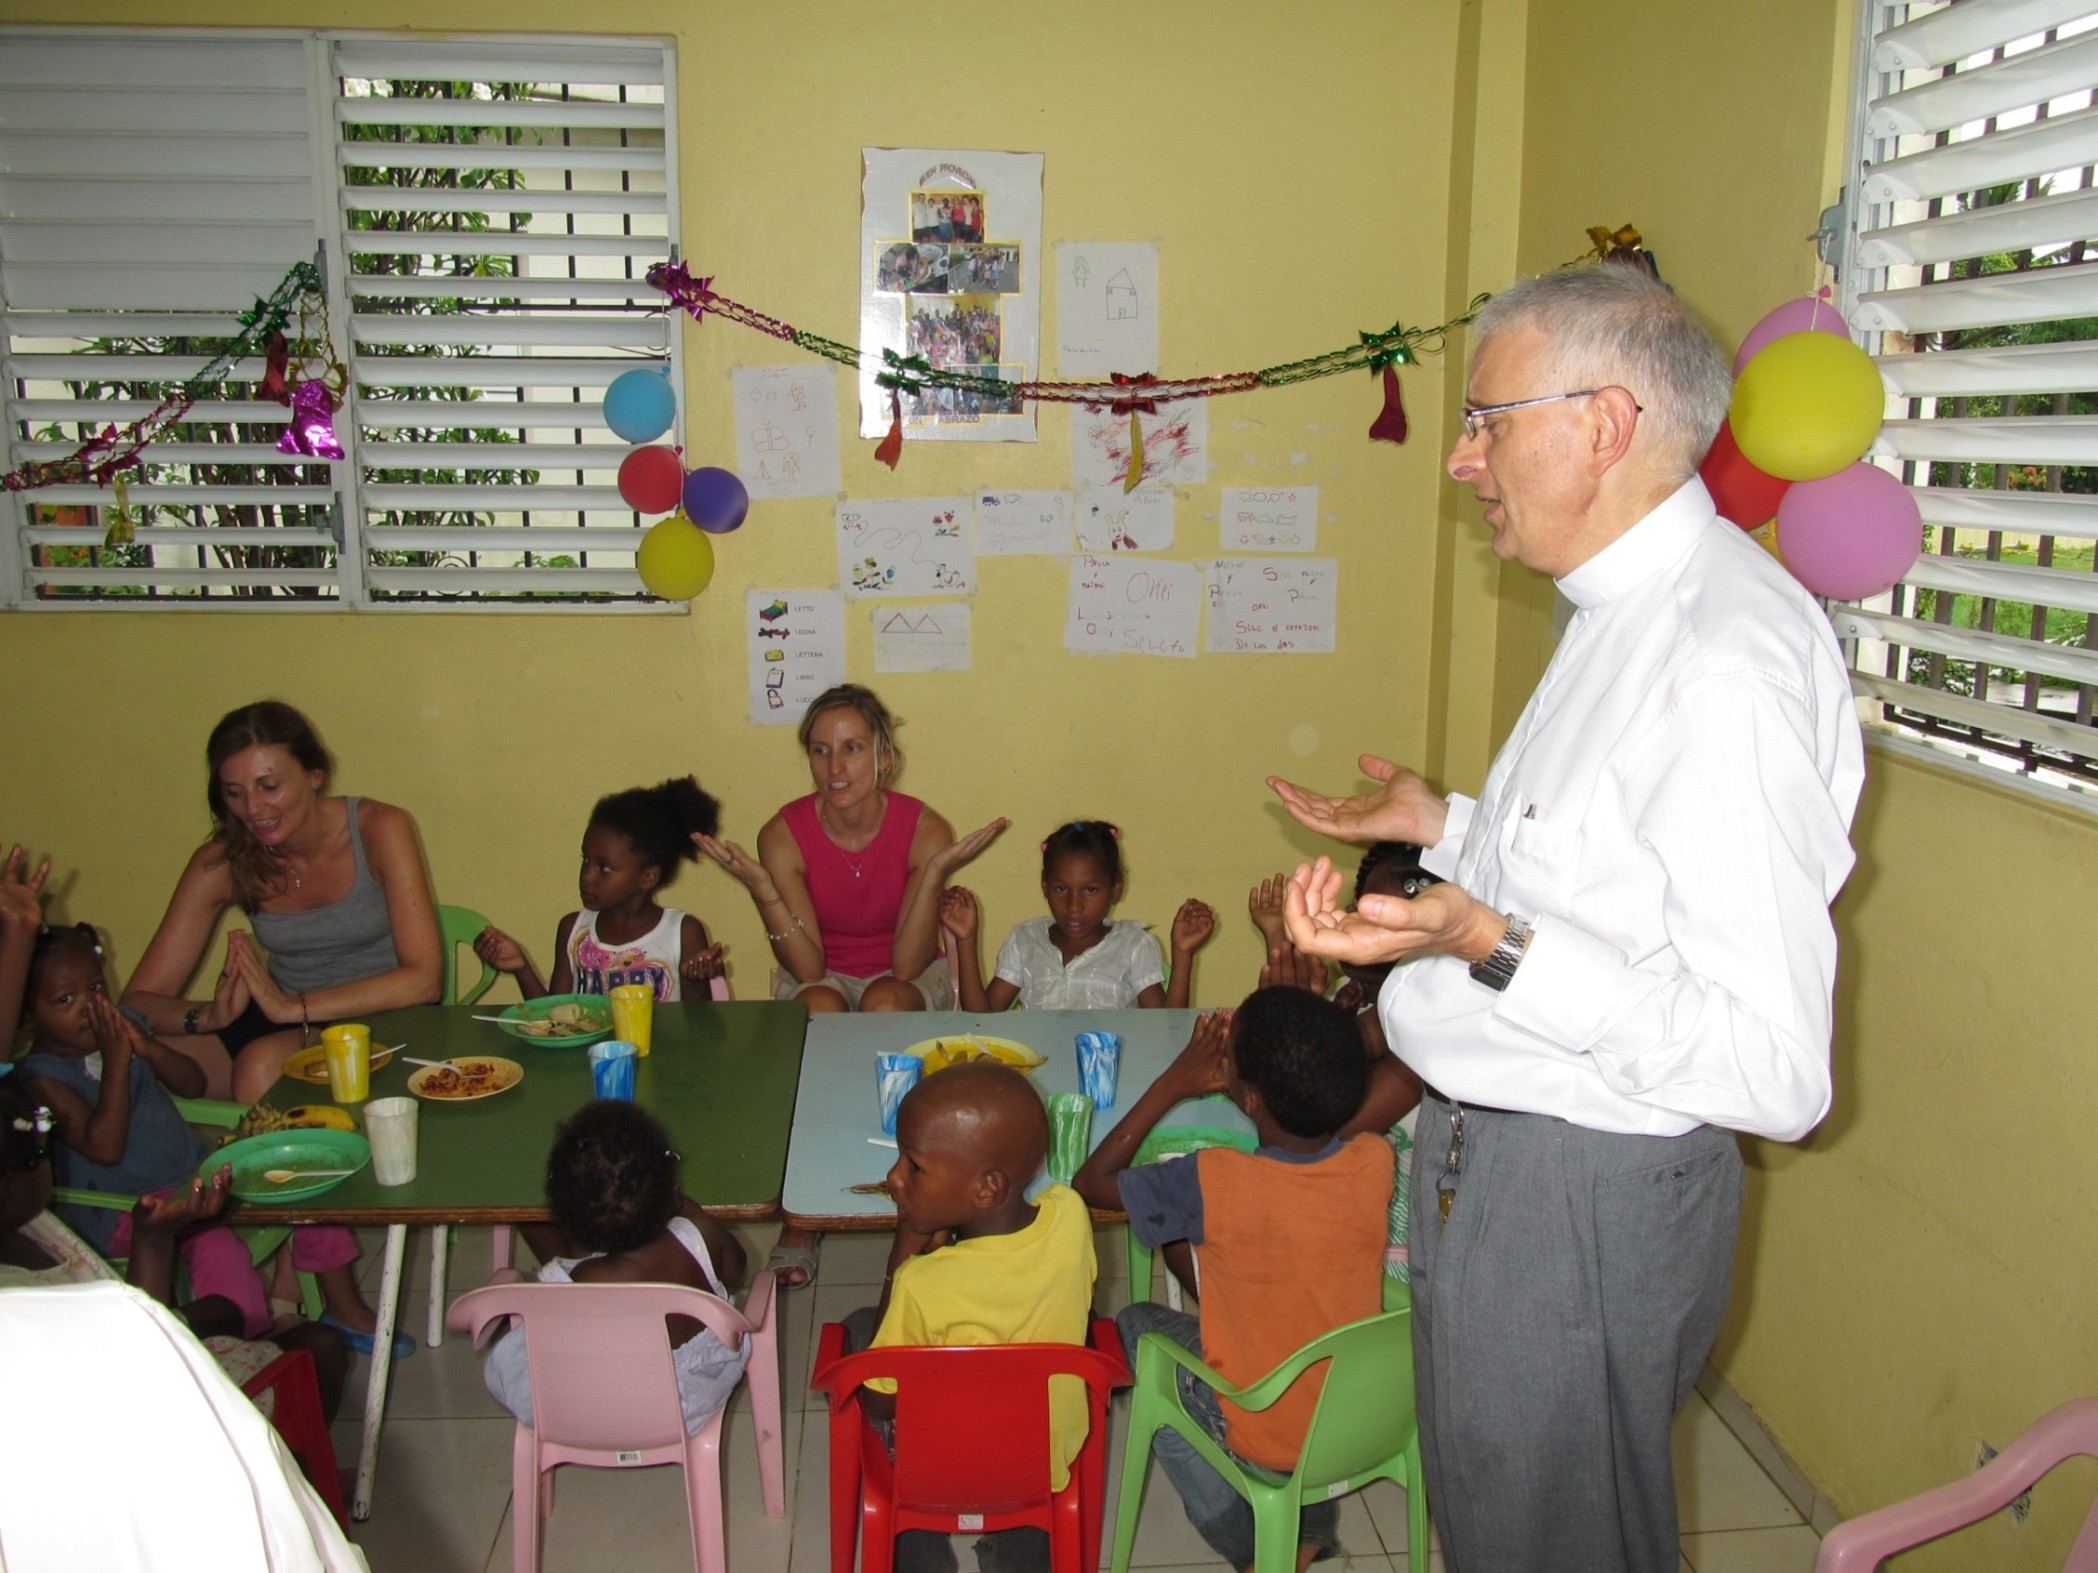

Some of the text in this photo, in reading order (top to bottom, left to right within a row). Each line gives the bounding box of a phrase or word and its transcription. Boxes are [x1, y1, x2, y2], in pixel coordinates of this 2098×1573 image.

[940, 164, 976, 189] PROVECHO
[938, 415, 980, 423] ABRAZO
[796, 651, 823, 659] LETTERA
